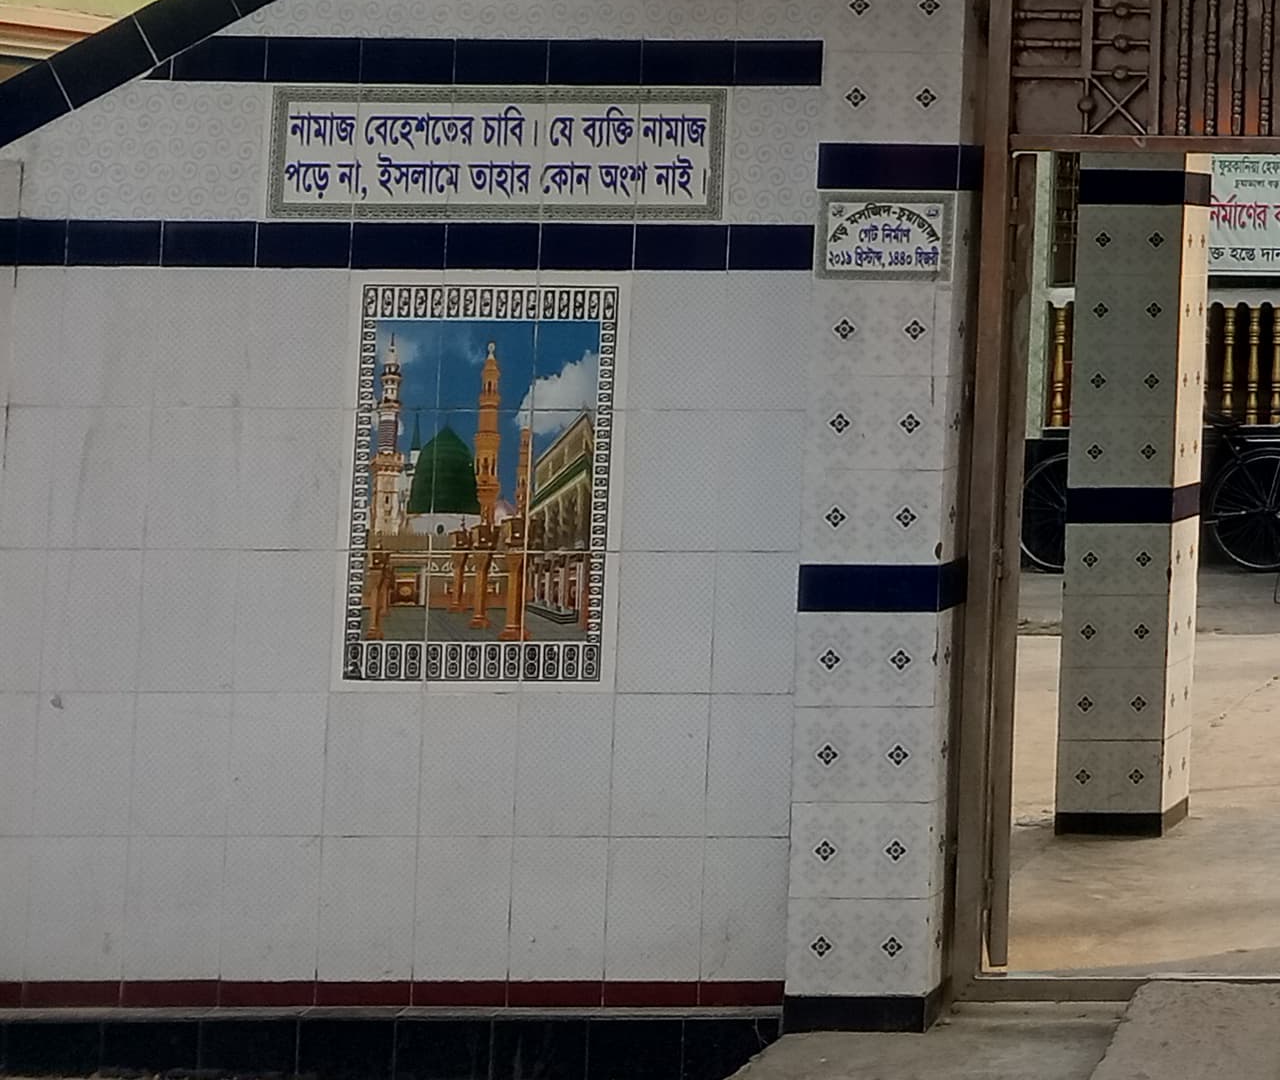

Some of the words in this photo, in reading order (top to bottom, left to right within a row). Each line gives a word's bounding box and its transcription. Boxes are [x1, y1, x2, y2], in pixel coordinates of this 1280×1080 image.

[289, 112, 357, 147] নামাজ
[364, 112, 474, 147] বেহেশতের
[549, 114, 573, 147] যে
[581, 106, 634, 149] ব্যক্তি
[642, 114, 708, 148] নামাজ
[285, 161, 331, 199] পড়ে
[337, 161, 368, 200] না,
[376, 152, 459, 194] ইসলামে
[469, 160, 531, 197] তাহার
[540, 164, 591, 196] কোন
[597, 161, 646, 197] অংশ
